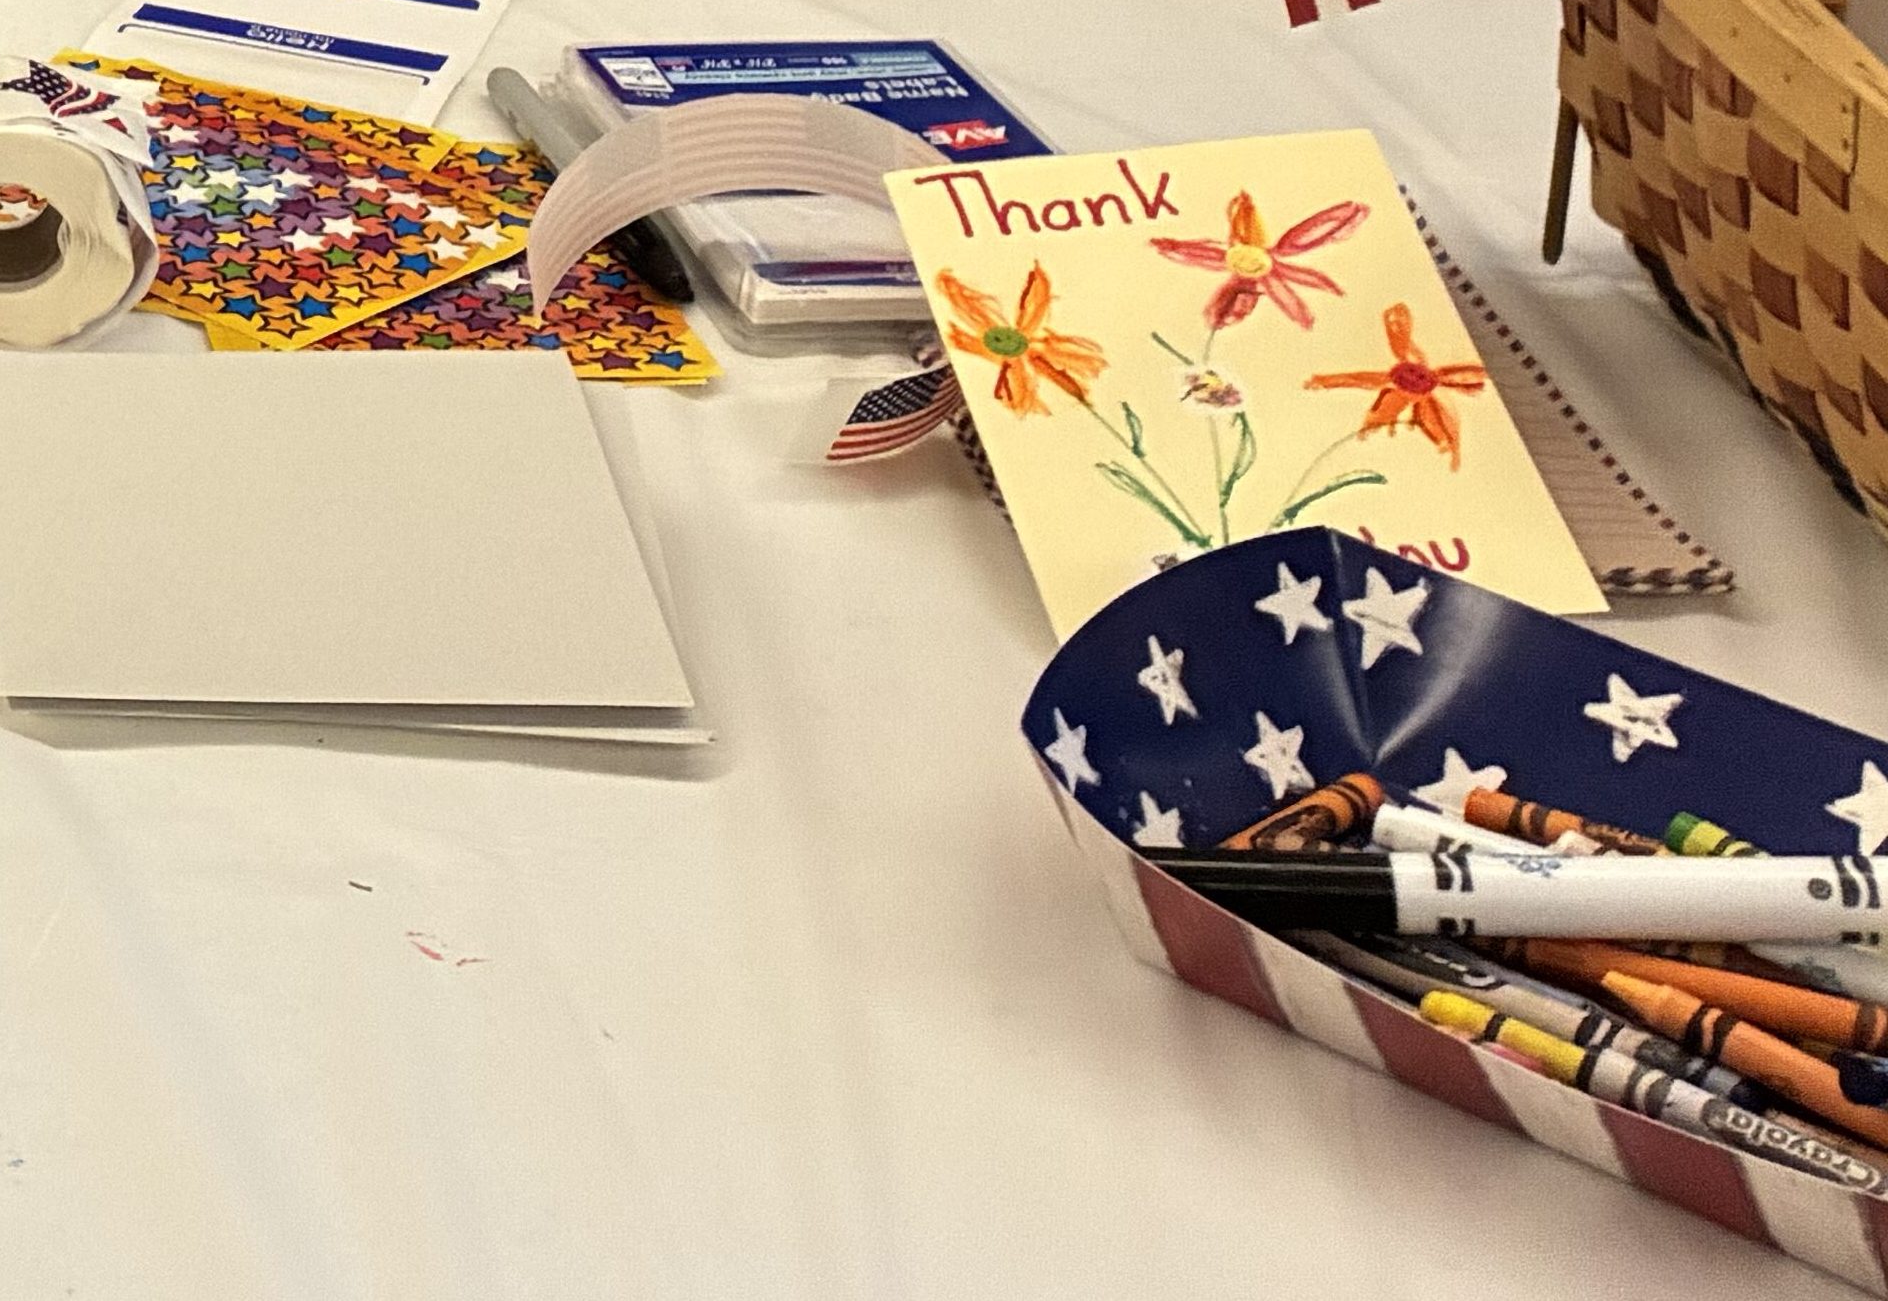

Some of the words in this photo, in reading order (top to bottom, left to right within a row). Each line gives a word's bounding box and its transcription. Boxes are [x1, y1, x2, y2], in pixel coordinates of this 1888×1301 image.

[246, 26, 330, 51] Hello
[811, 90, 884, 104] Badg
[887, 86, 970, 100] Name
[922, 124, 1008, 146] AVE
[915, 159, 1179, 237] Thank
[1358, 526, 1470, 574] ou
[1721, 1107, 1880, 1191] Crayola
